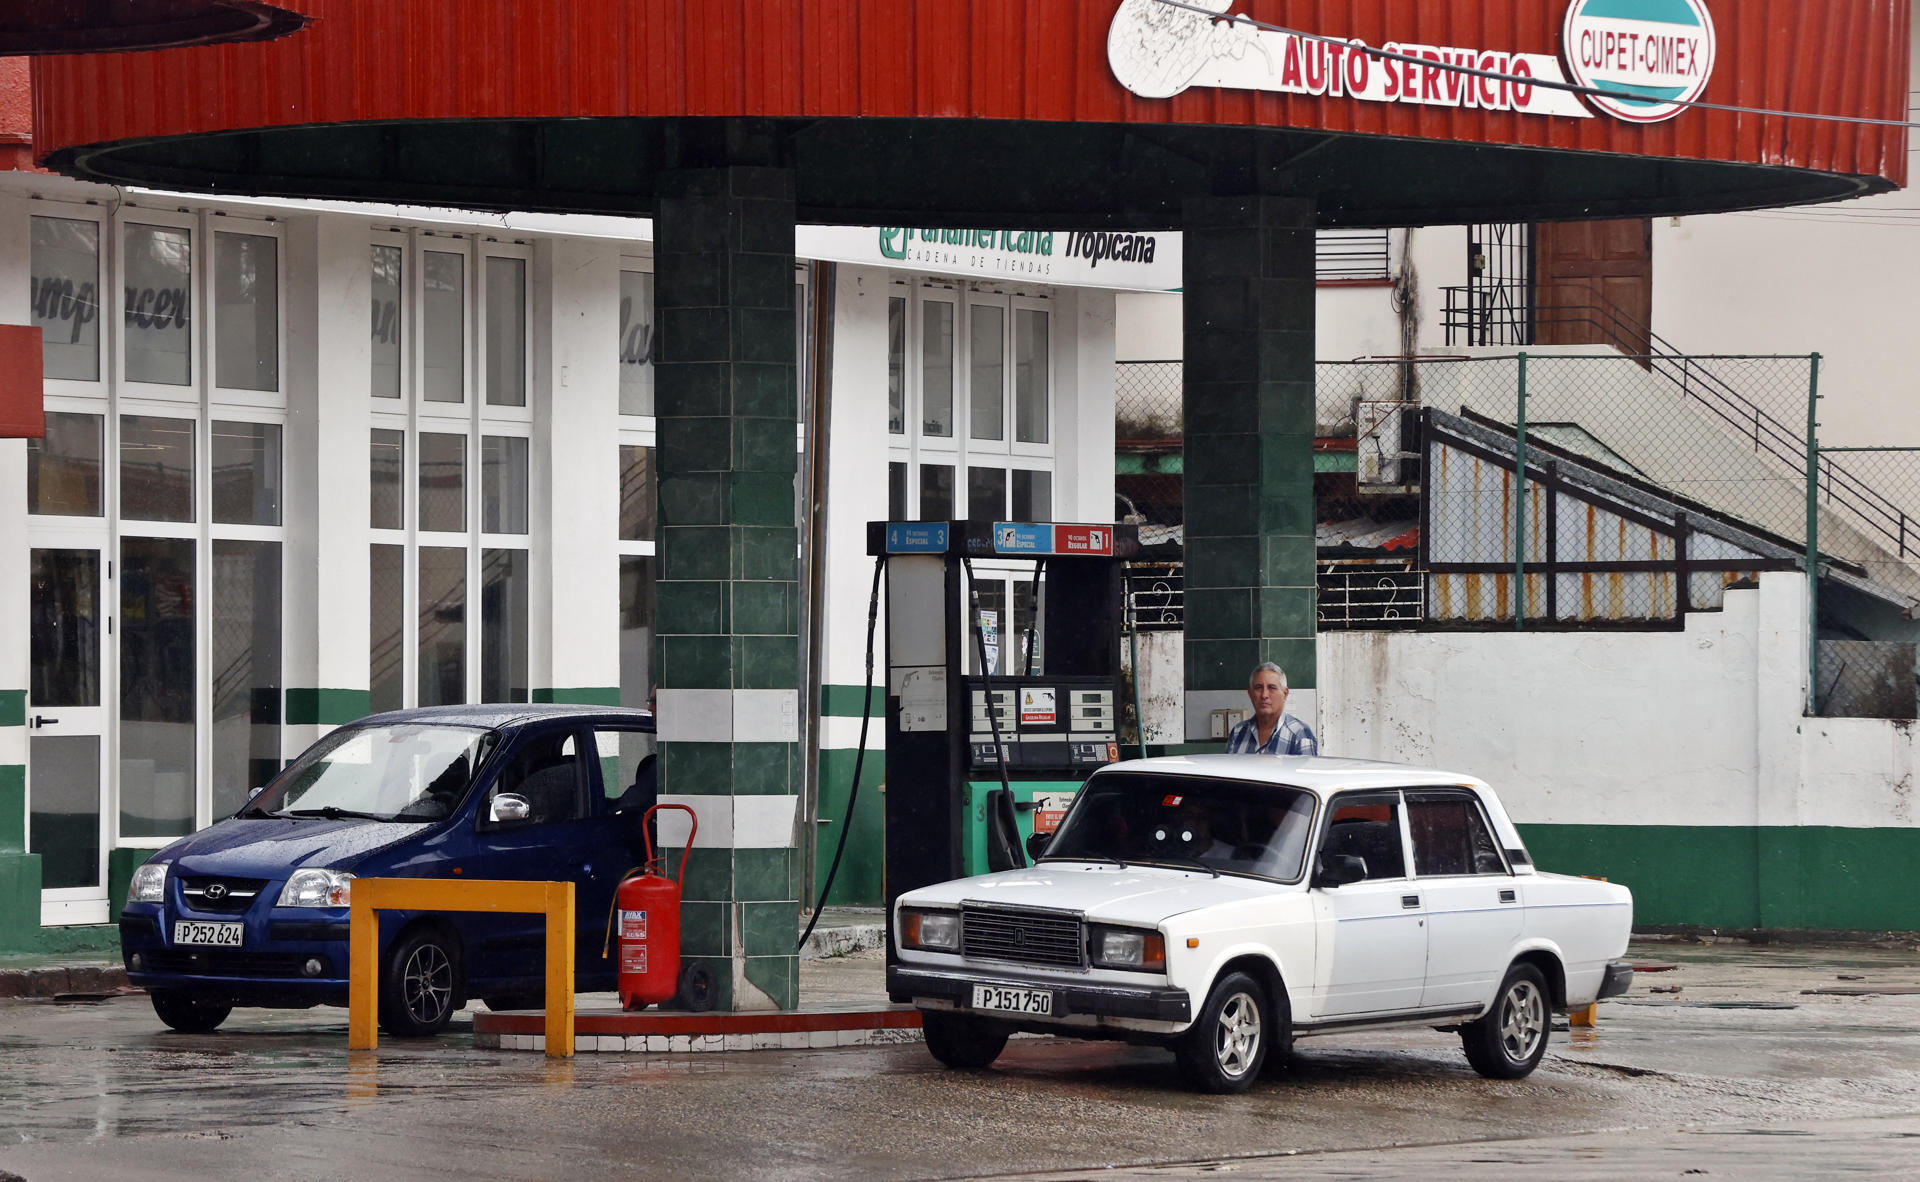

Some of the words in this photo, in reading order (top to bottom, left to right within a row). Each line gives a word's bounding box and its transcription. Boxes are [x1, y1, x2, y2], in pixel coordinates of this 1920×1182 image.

[1580, 28, 1698, 76] CUPET-CIMEX
[1281, 37, 1369, 93] AUTO
[1383, 48, 1533, 107] SERVICIO
[907, 248, 957, 265] CADENA
[970, 255, 984, 268] DE
[995, 257, 1051, 275] TIENDAS
[937, 529, 944, 545] 3
[1105, 533, 1109, 549] 1
